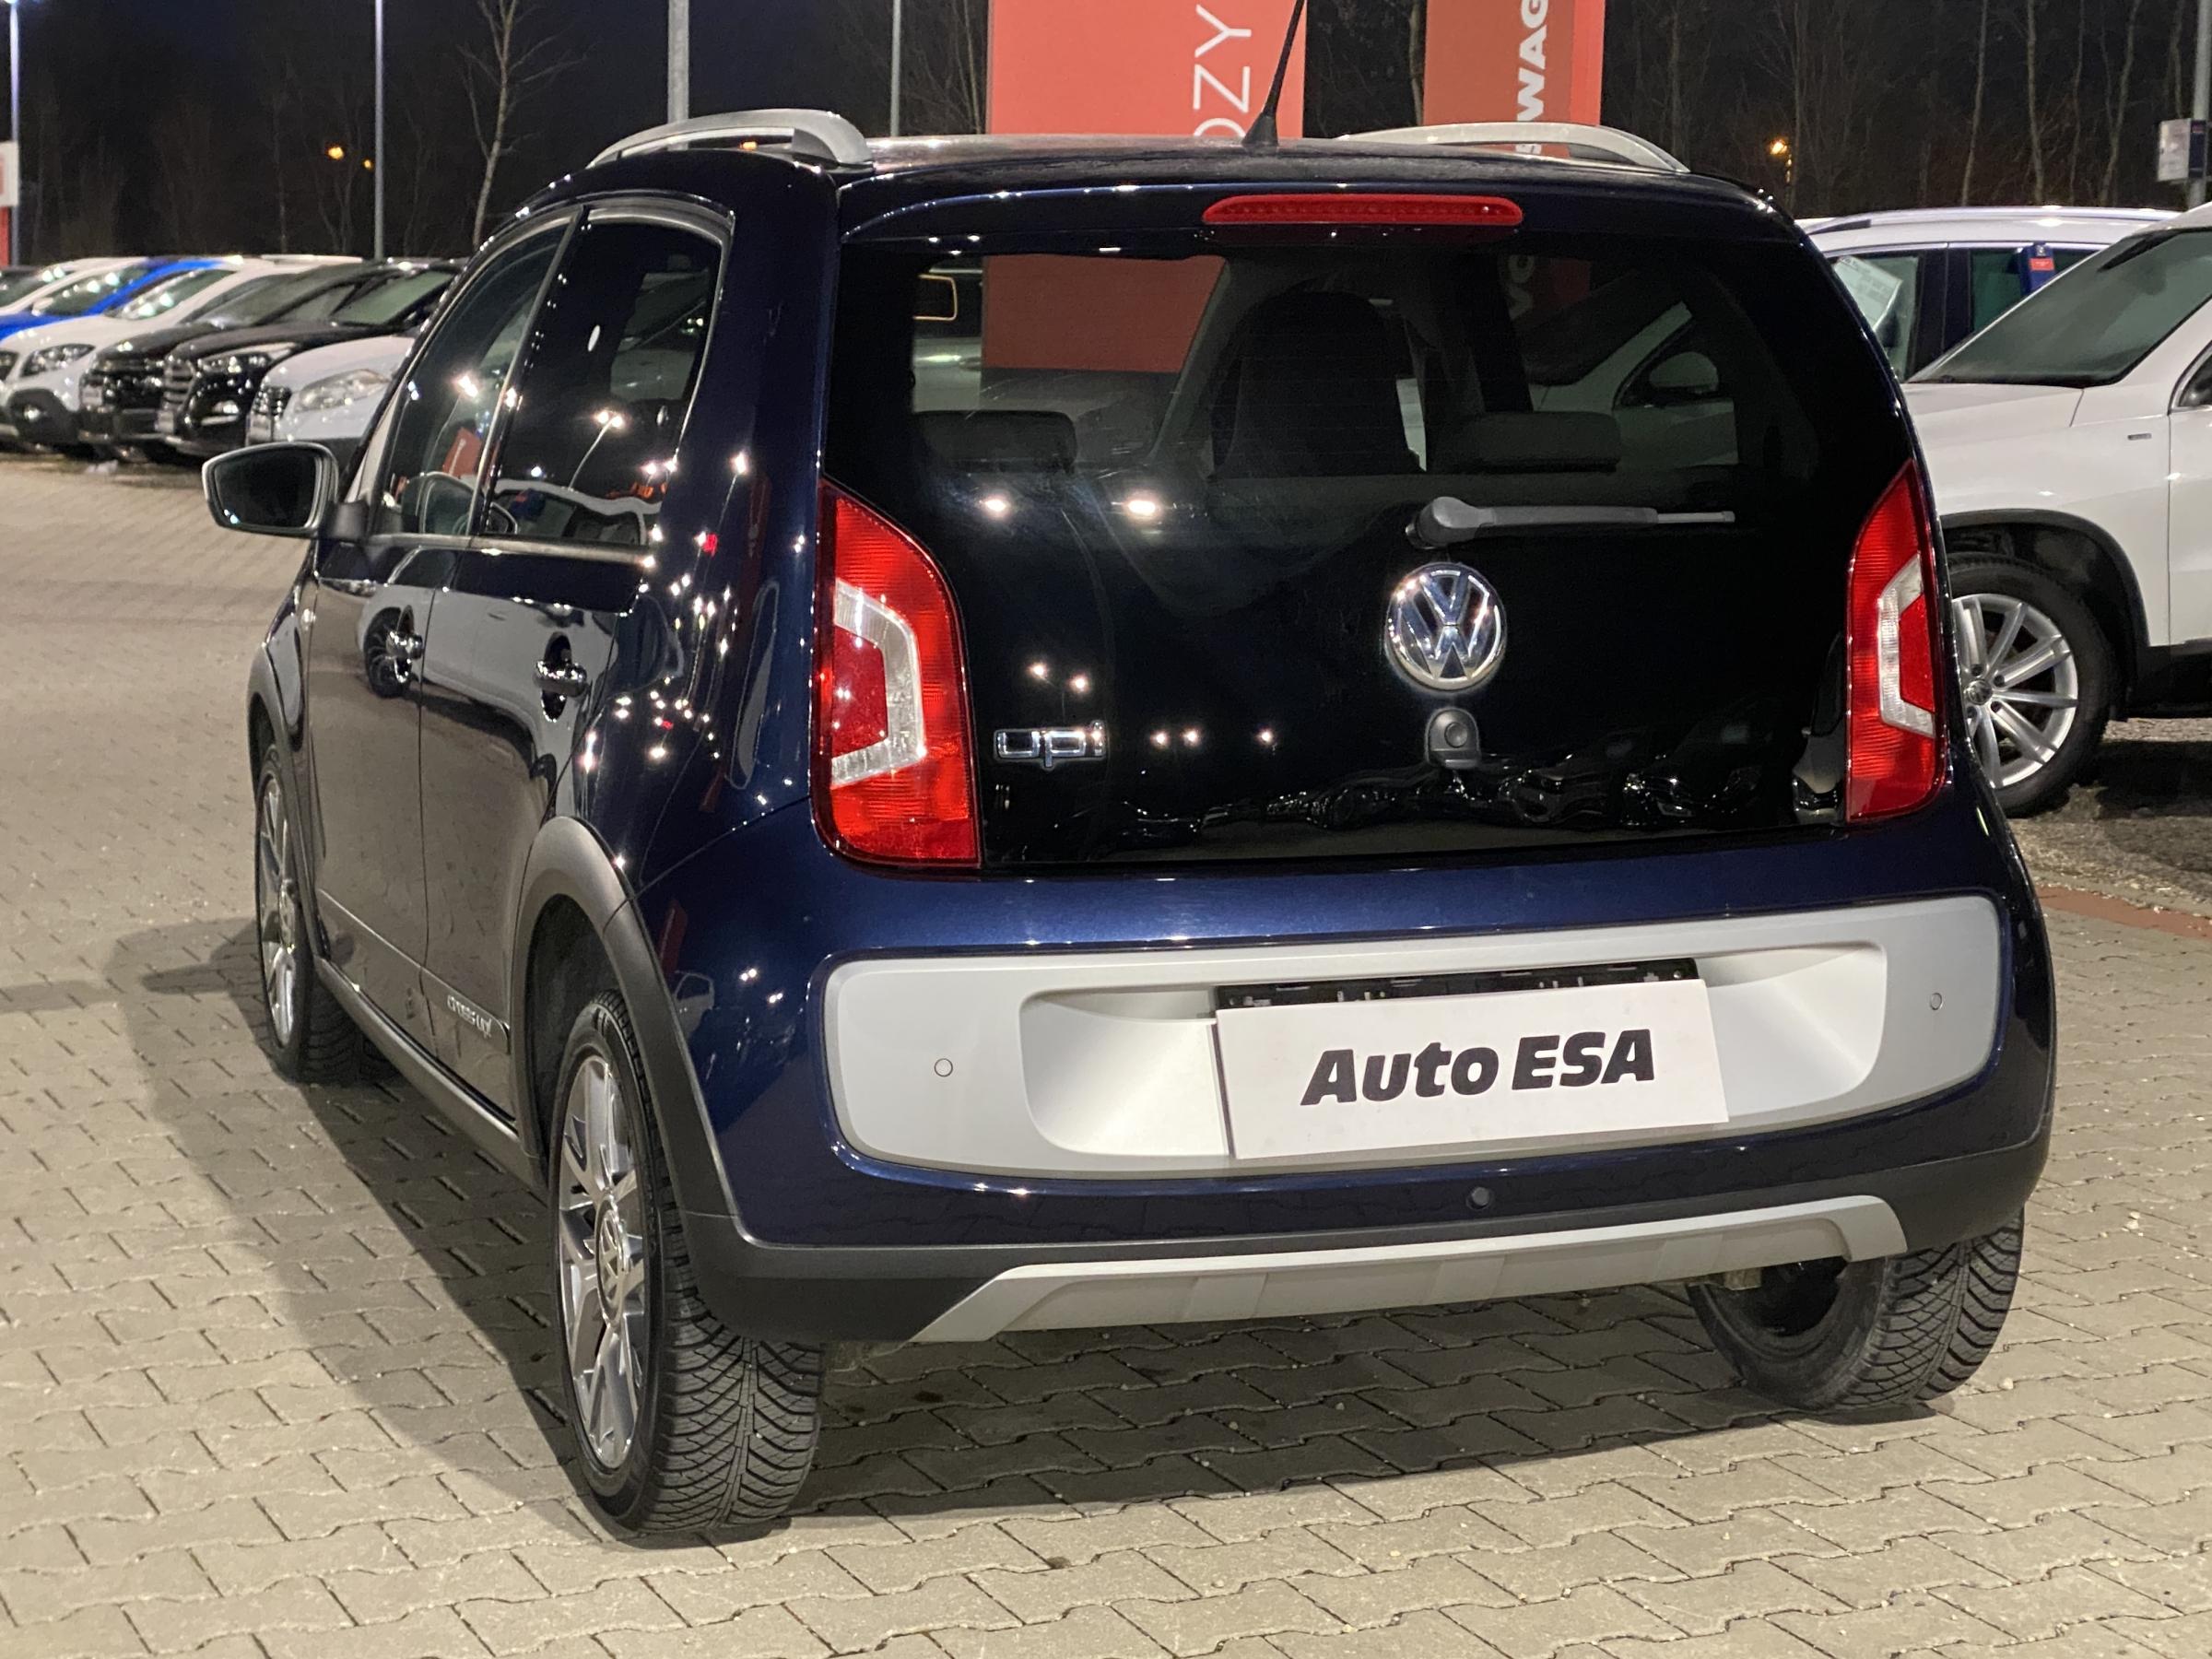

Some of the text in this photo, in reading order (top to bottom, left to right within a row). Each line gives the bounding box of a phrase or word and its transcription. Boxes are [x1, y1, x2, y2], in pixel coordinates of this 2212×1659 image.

[1515, 0, 1548, 155] WAG
[1300, 1028, 1655, 1106] Auto ESA
